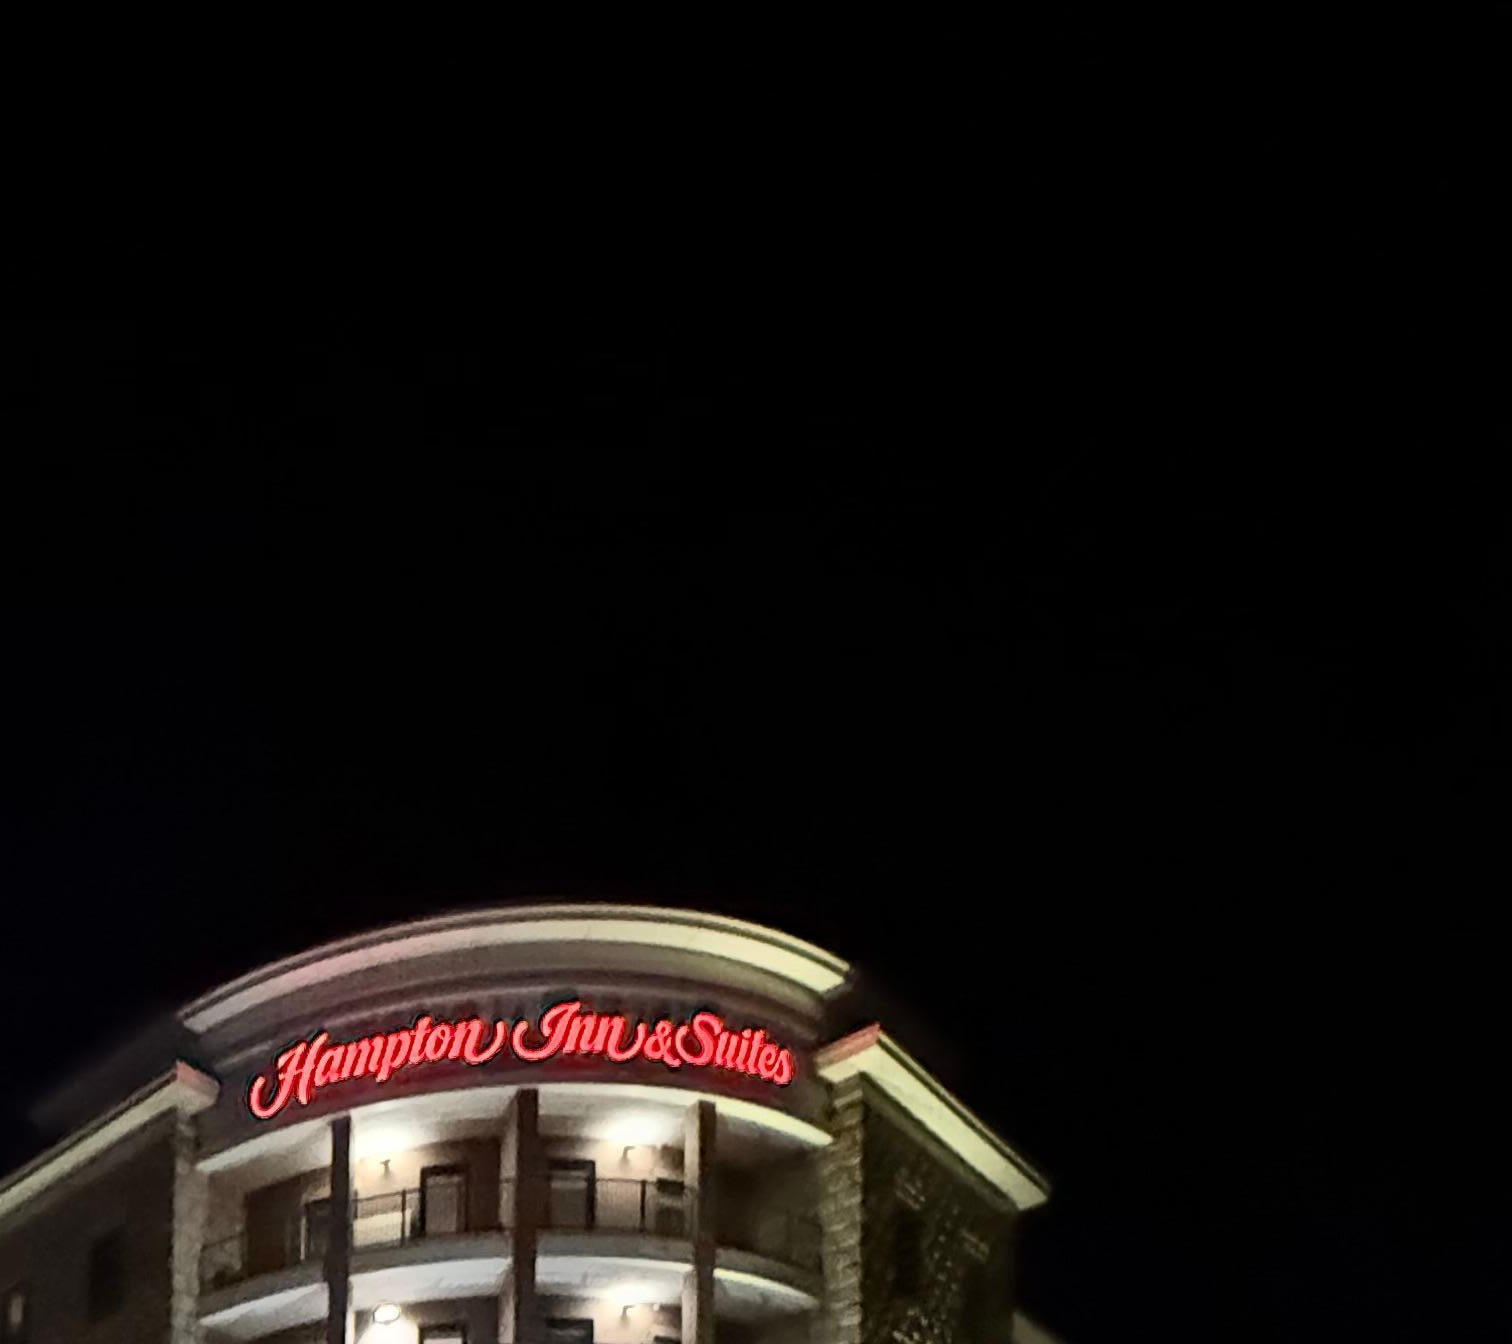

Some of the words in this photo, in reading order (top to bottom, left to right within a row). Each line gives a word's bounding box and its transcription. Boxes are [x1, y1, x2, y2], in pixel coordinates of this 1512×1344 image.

[249, 1015, 506, 1118] Hampton
[511, 1001, 647, 1063] Inn
[675, 1011, 794, 1085] Suites
